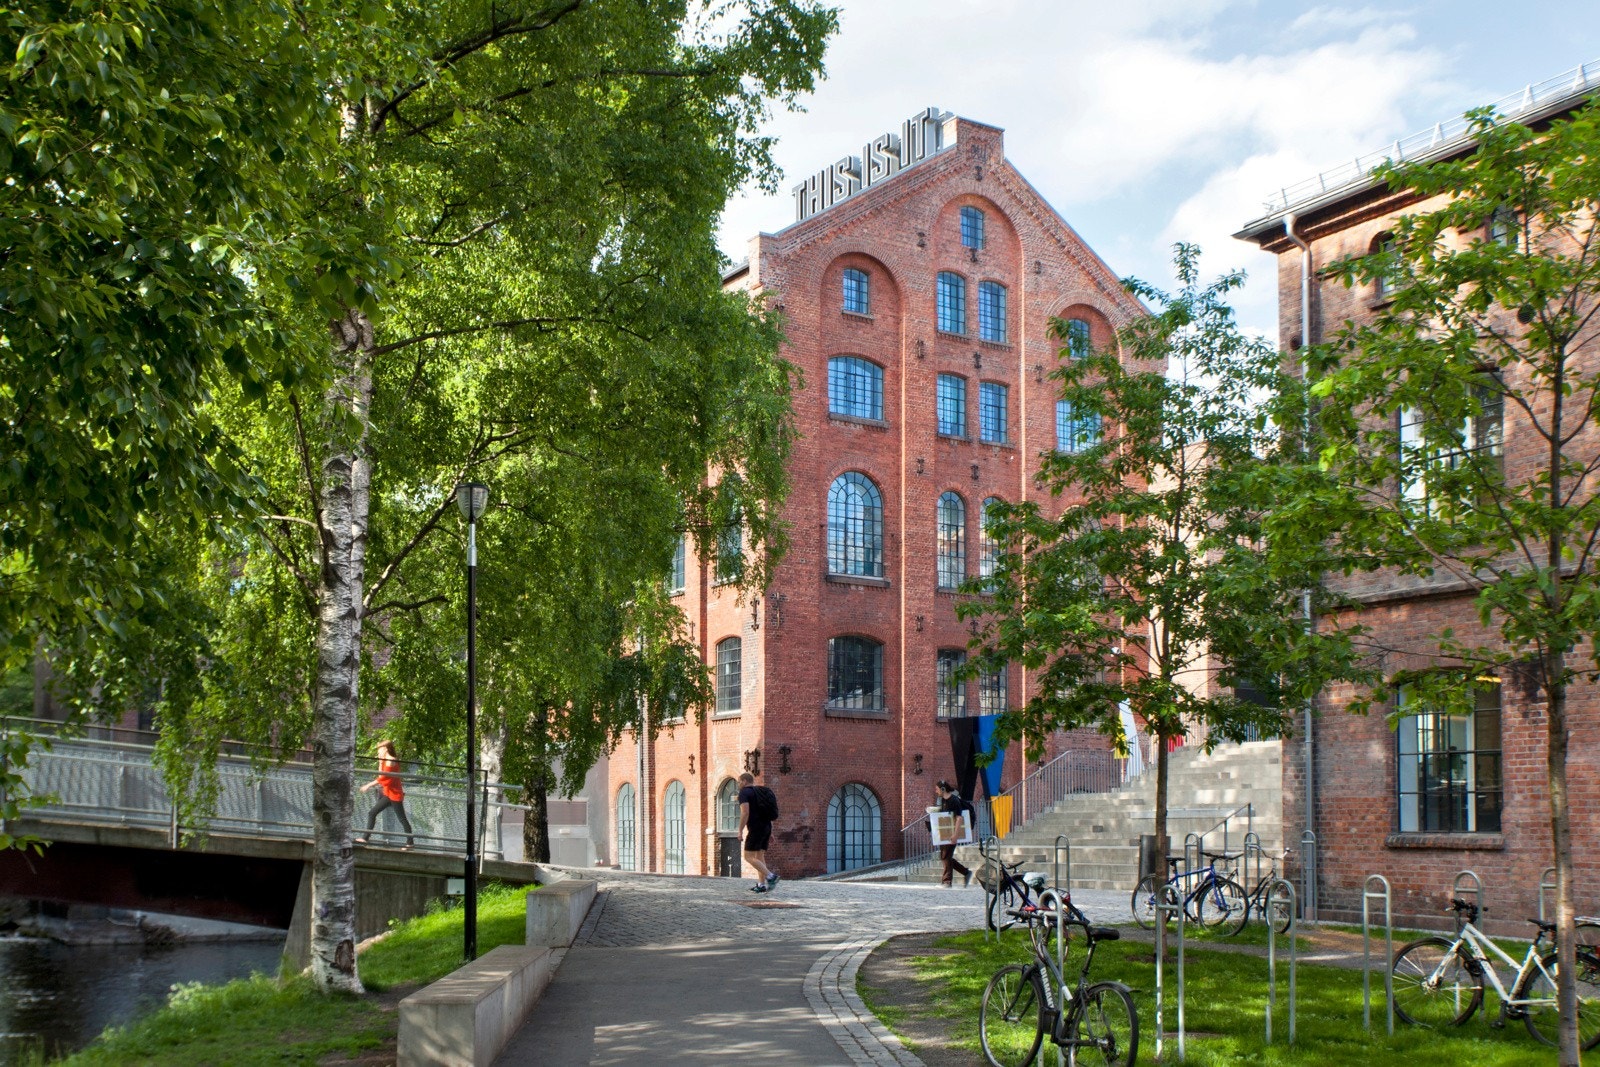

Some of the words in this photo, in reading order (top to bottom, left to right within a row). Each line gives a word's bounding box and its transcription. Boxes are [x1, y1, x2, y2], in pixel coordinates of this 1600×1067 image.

[792, 155, 853, 222] THIS
[861, 132, 892, 188] IS
[900, 107, 933, 168] IT
[1040, 967, 1054, 1008] DIAMANT
